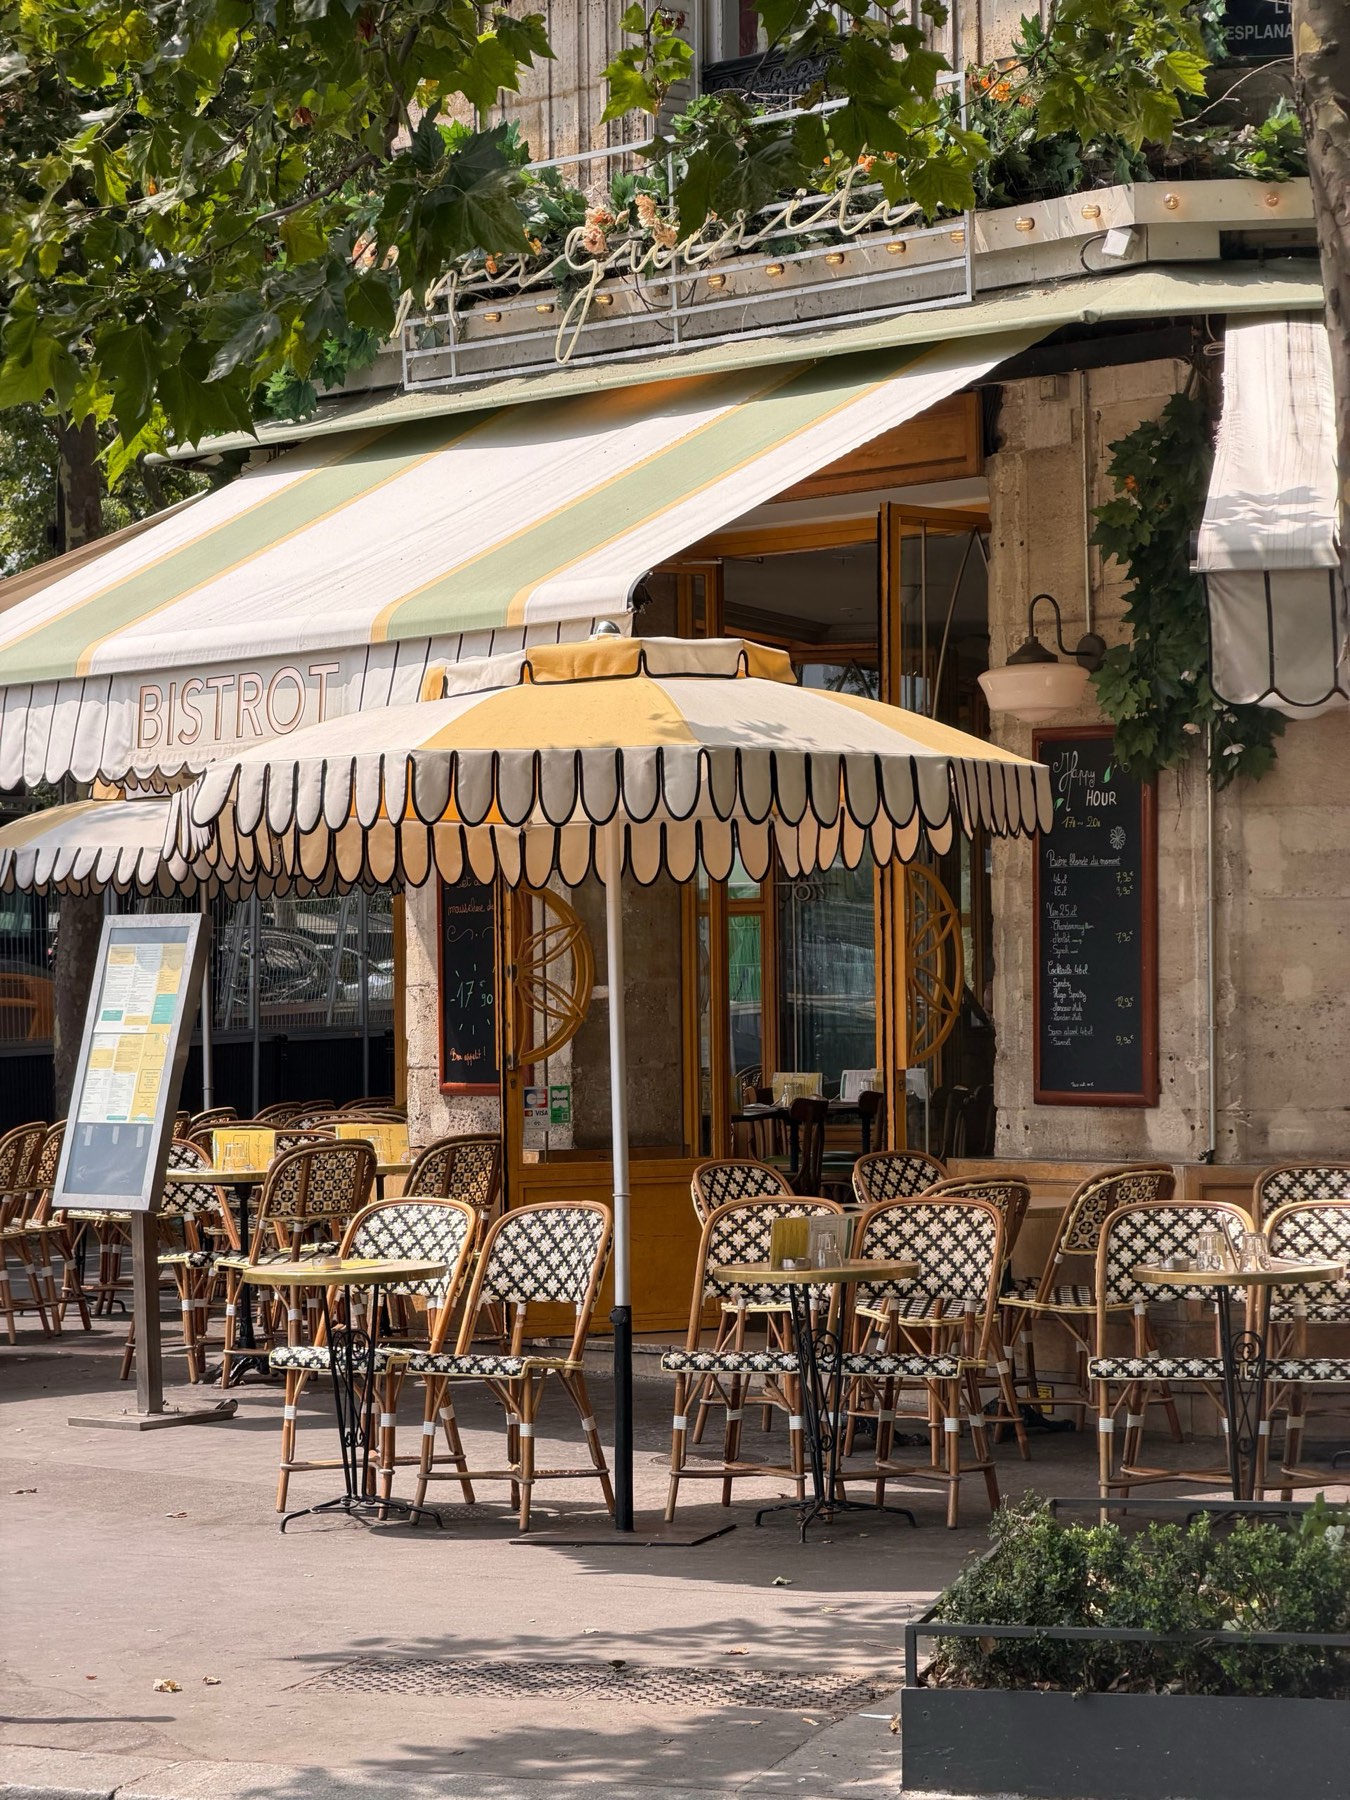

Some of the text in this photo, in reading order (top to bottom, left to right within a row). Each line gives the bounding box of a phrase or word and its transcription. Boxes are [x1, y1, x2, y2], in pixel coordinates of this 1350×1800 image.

[137, 662, 341, 749] BISTROT
[1053, 750, 1096, 812] Happy
[1085, 789, 1117, 807] HOUR
